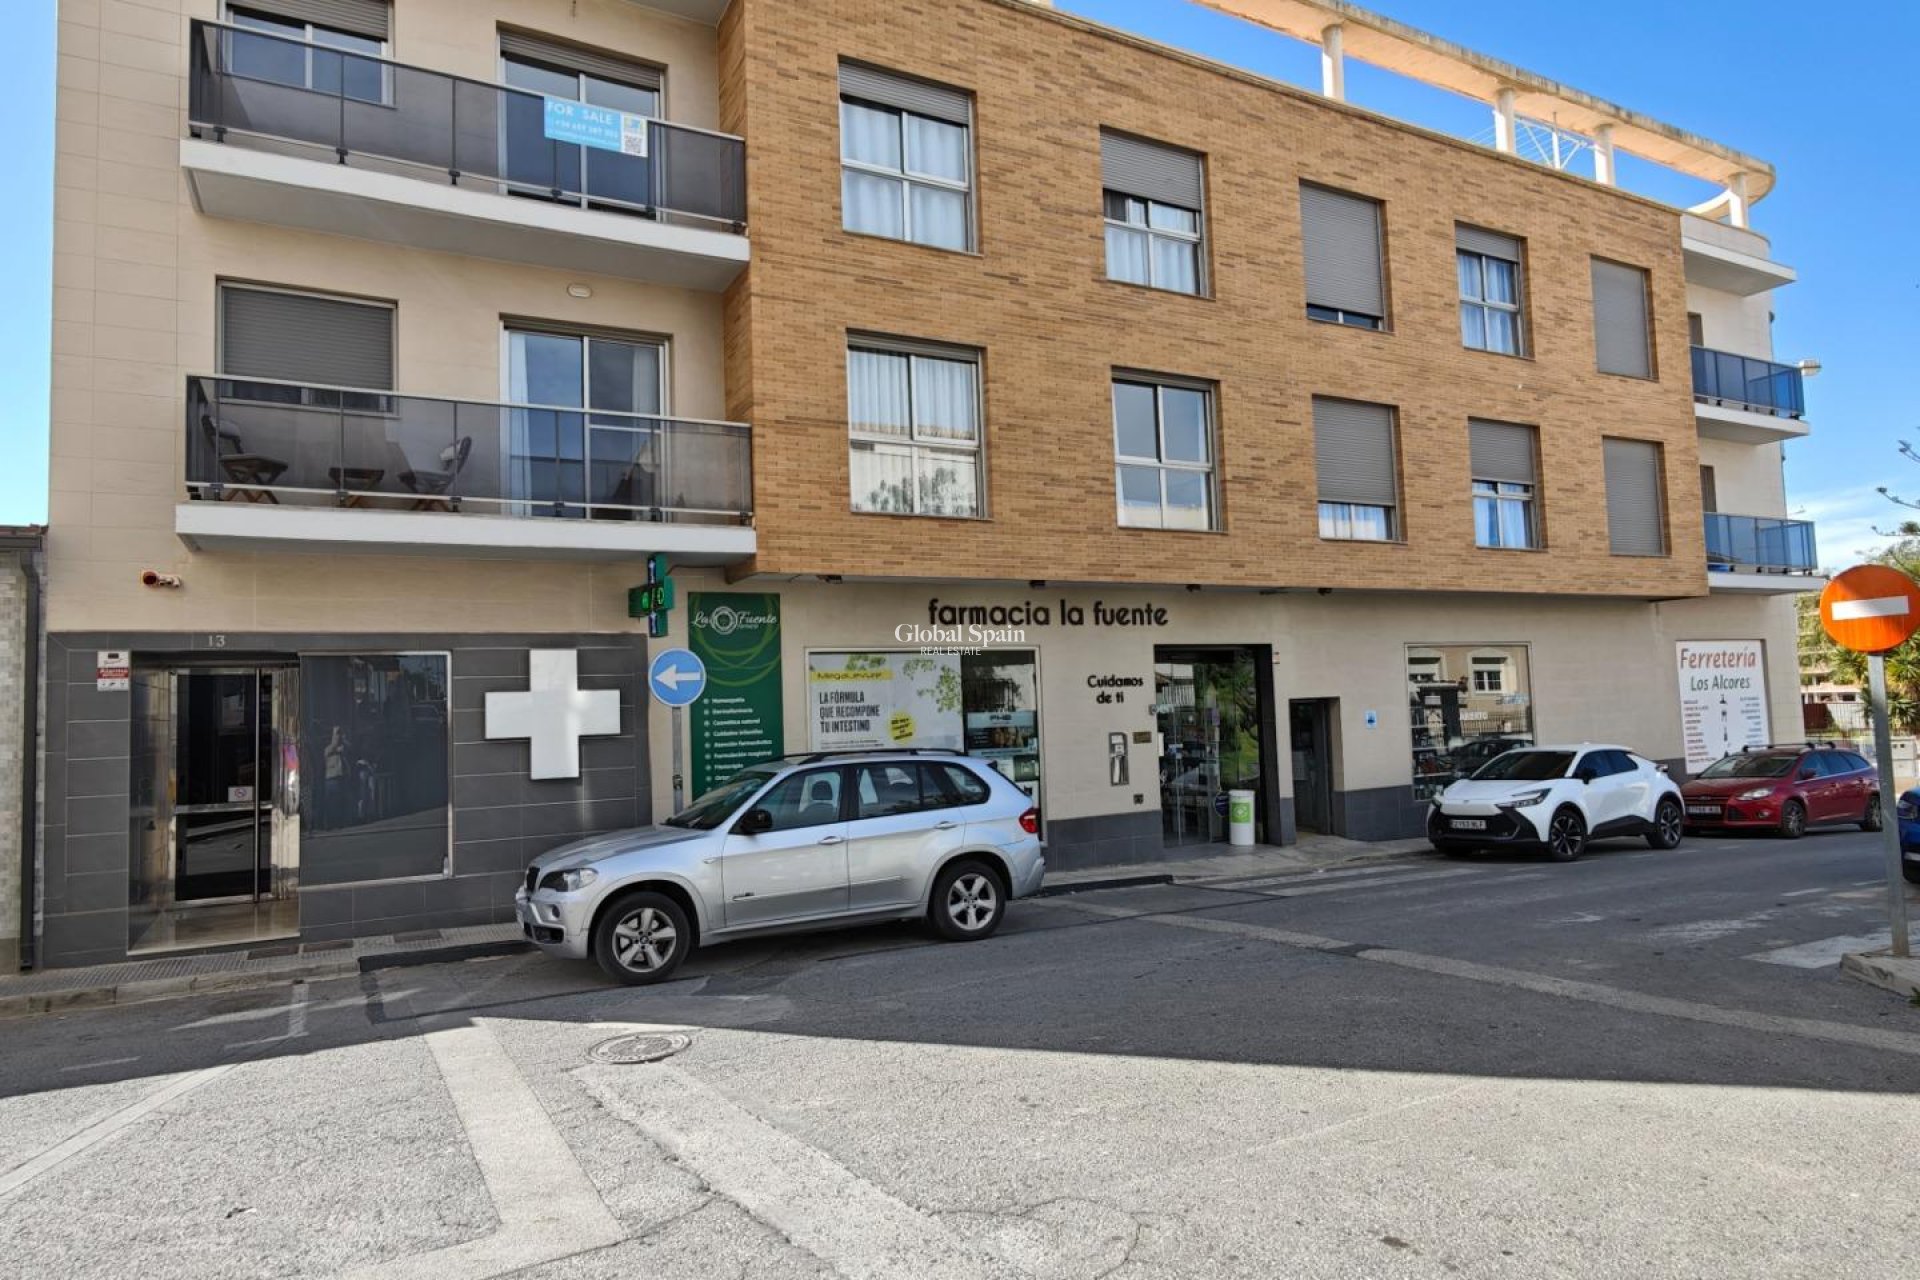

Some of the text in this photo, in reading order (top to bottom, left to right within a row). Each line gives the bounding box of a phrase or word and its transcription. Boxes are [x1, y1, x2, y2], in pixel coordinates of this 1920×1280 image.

[547, 100, 614, 126] FOR SALE
[690, 610, 777, 629] La Fuente
[928, 598, 1169, 626] farmacia la fuente
[207, 635, 226, 648] 13
[1680, 646, 1757, 670] Ferretería
[1087, 674, 1144, 689] Cuidamos
[1690, 676, 1709, 692] Los
[819, 689, 865, 704] LA FÓRMULA
[1096, 691, 1125, 704] de ti
[819, 704, 880, 720] QUE RECOMPONE
[820, 719, 870, 733] TU INTESTINO
